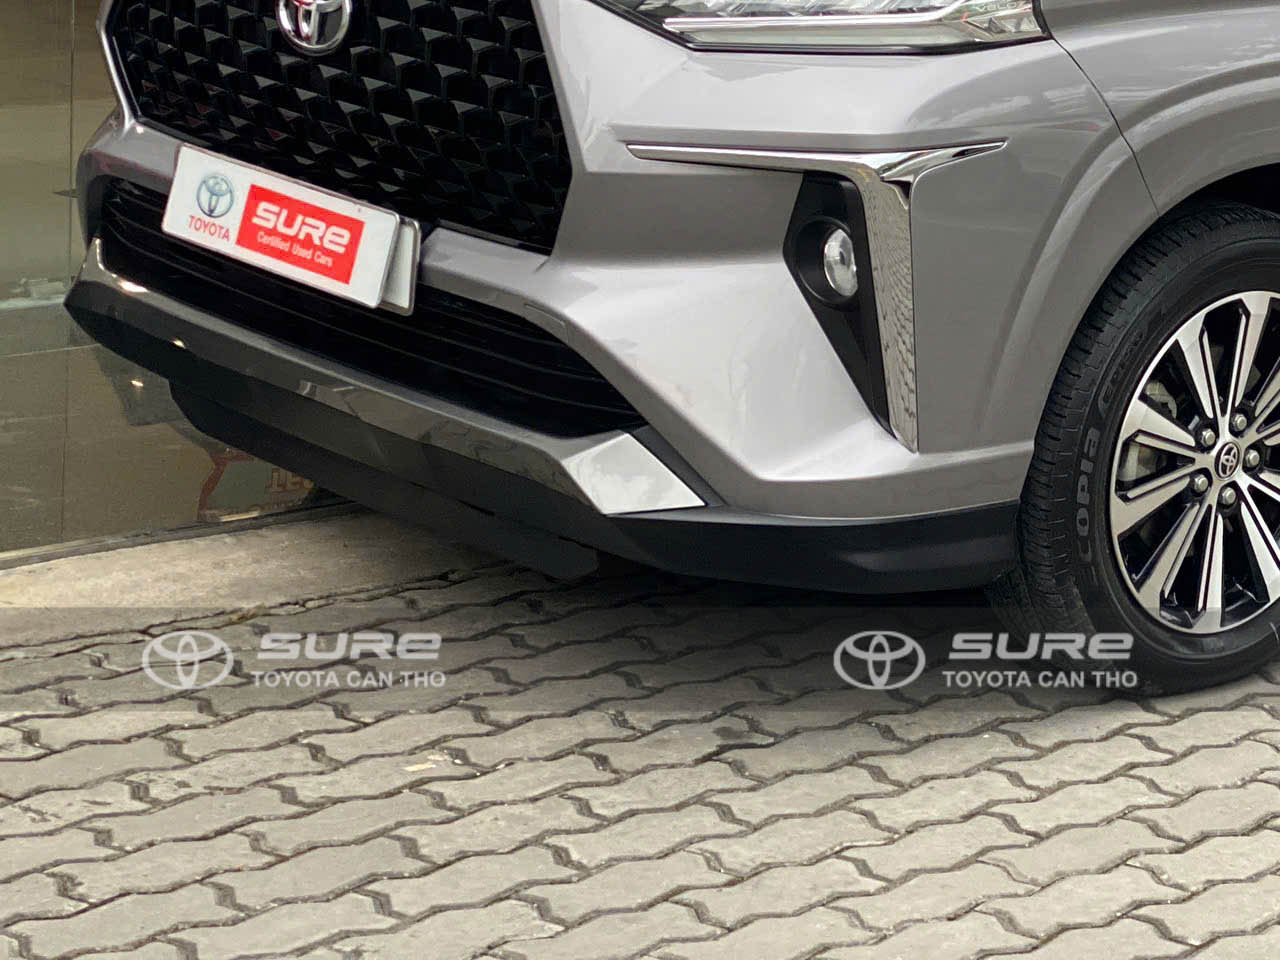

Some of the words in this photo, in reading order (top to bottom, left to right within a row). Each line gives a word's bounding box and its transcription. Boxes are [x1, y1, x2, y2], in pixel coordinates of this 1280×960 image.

[187, 215, 231, 243] TOYOTA
[251, 201, 351, 255] SURE
[257, 231, 291, 253] Certified
[292, 239, 313, 261] Used
[313, 249, 334, 269] Cars
